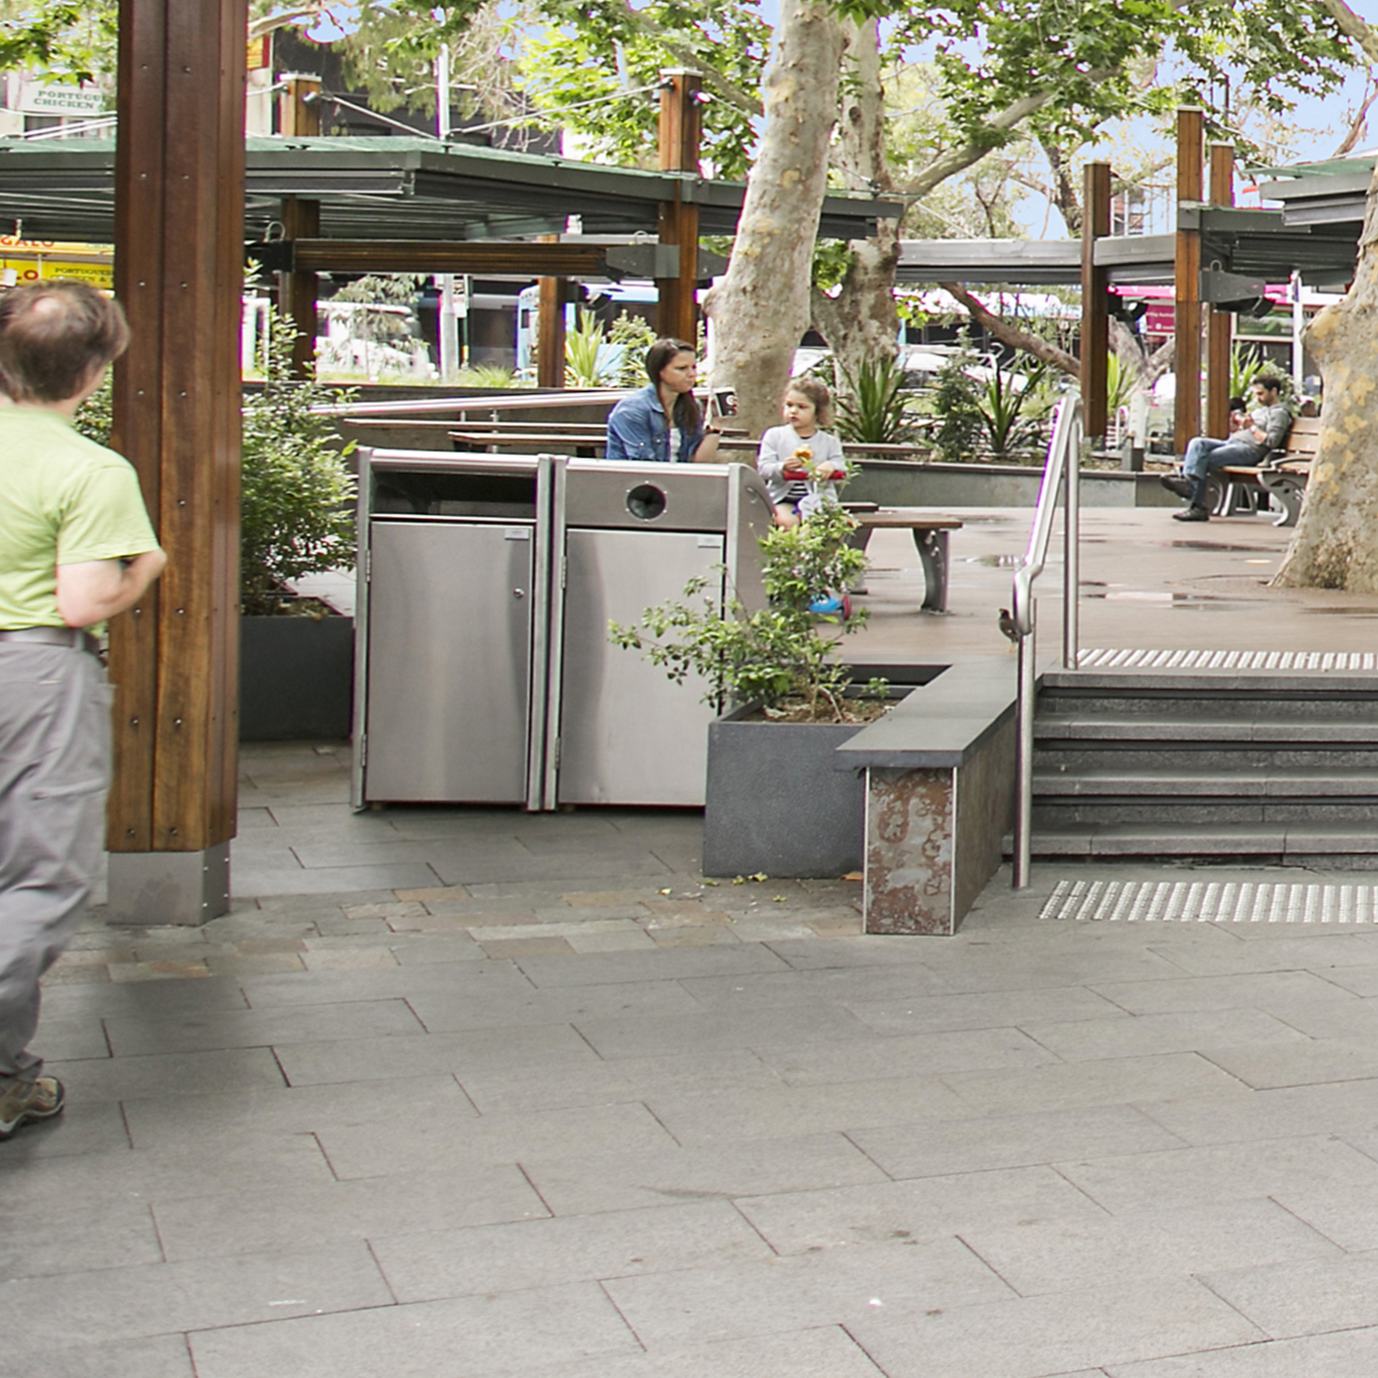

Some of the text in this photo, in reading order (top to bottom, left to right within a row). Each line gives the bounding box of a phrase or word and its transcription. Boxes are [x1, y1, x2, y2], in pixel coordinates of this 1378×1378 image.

[38, 90, 105, 102] PORTUGU
[34, 98, 94, 109] CHICKEN
[55, 267, 113, 276] PORTUGUES
